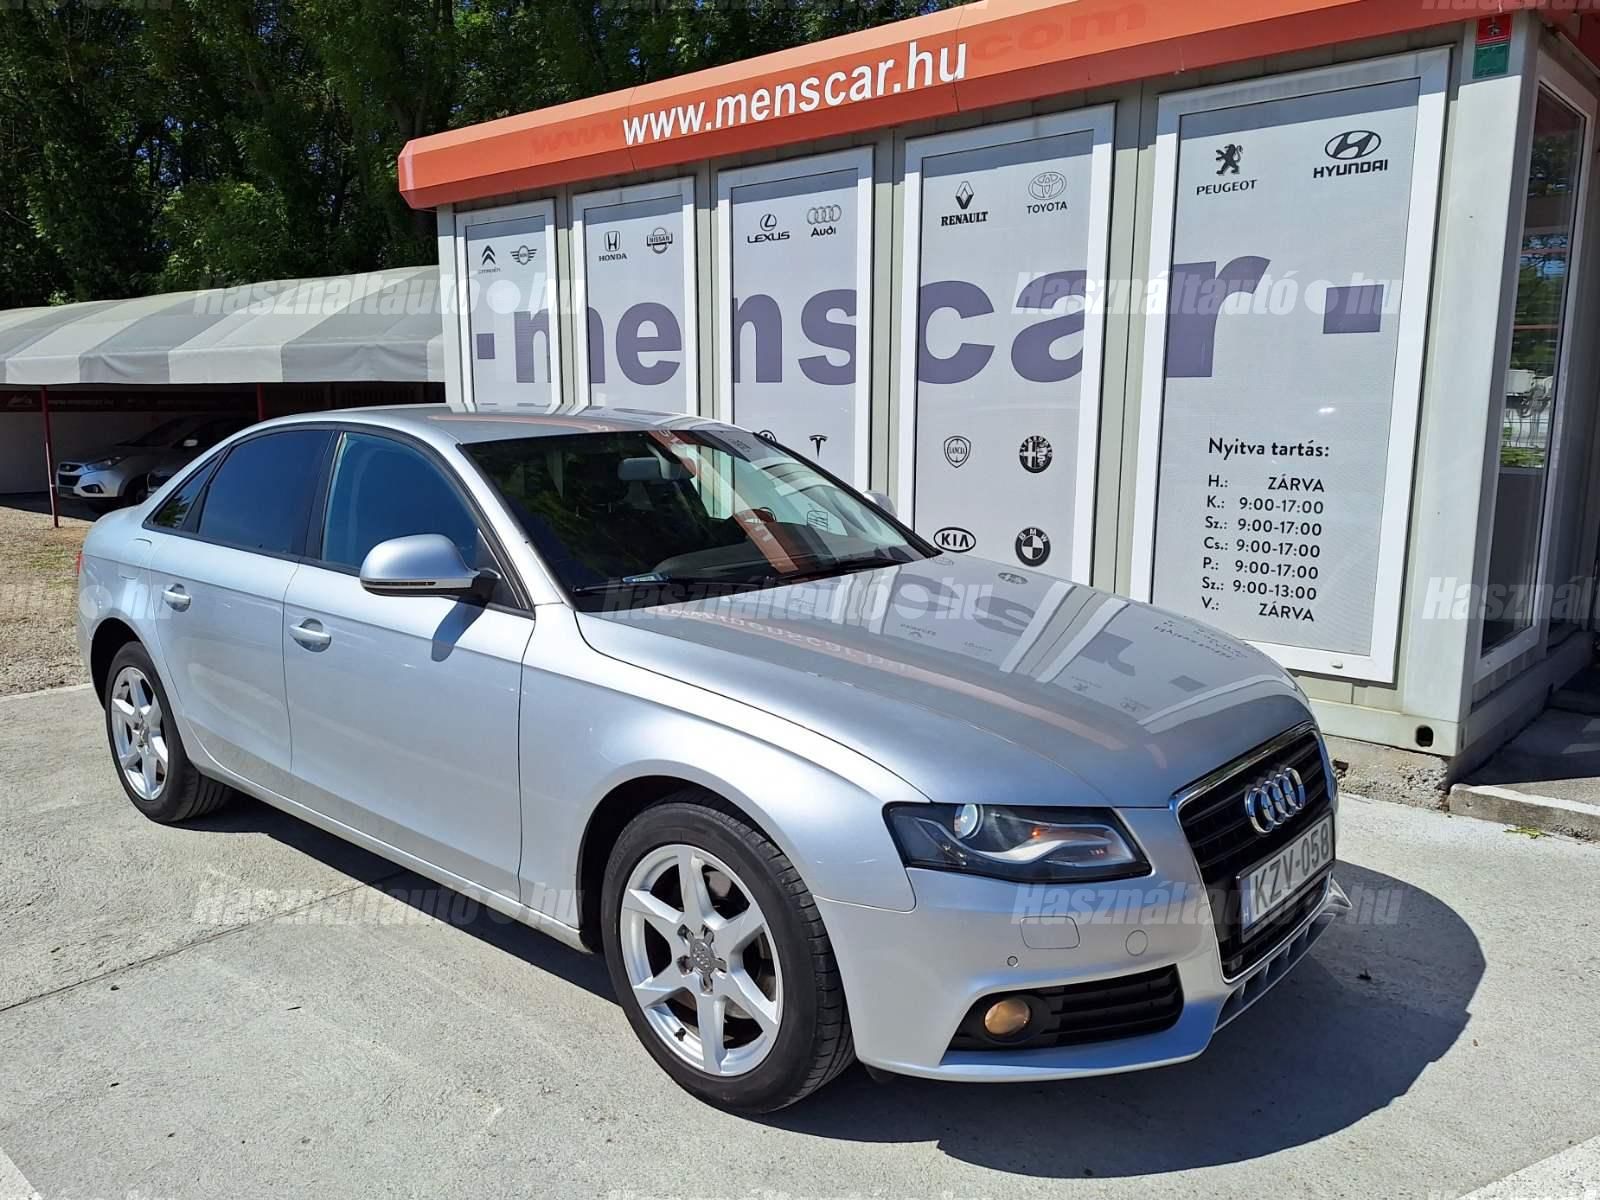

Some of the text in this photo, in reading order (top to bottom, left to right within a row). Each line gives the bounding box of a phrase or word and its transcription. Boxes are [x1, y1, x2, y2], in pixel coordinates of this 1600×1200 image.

[622, 41, 966, 145] www.menscar.hu
[1313, 159, 1388, 178] HYUNDAI
[1196, 179, 1257, 195] PEUGEOT
[1026, 200, 1068, 214] TOYOTA
[941, 211, 988, 226] RENAULT
[747, 231, 790, 243] LEXUS
[811, 226, 836, 237] Audi
[598, 253, 628, 262] HONDA
[1208, 437, 1329, 461] Nyitva tartás:
[1208, 473, 1325, 492] H.: ZÁRVA
[1207, 495, 1324, 514] K.: 9:00-17:00
[1205, 516, 1322, 536] Sz.: 9:00-17:00
[941, 533, 969, 548] KIA
[1203, 536, 1320, 558] Cs.: 9:00-17:00
[1203, 557, 1319, 579] P.: 9:00-17:00
[1202, 576, 1317, 600] Sz.: 9:00-13:00
[1201, 596, 1315, 622] V.: ZÁRVA
[1254, 823, 1329, 915] KZV-058
